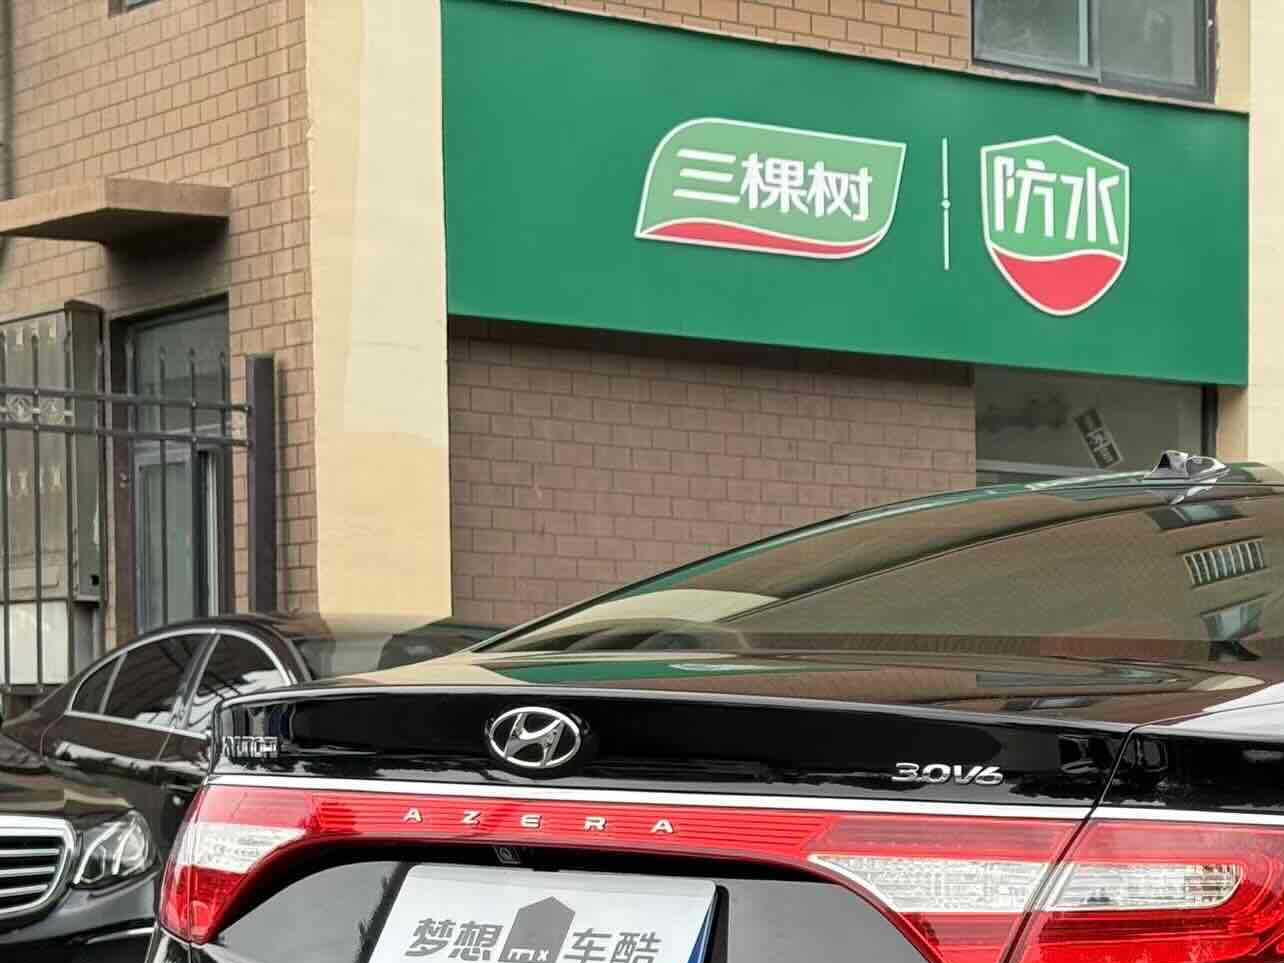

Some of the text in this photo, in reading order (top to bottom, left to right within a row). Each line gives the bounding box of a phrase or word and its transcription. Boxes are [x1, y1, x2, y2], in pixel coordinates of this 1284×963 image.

[672, 147, 873, 222] 三棵树
[993, 155, 1120, 244] 防水
[403, 806, 676, 834] AZERA
[404, 917, 505, 962] 梦想
